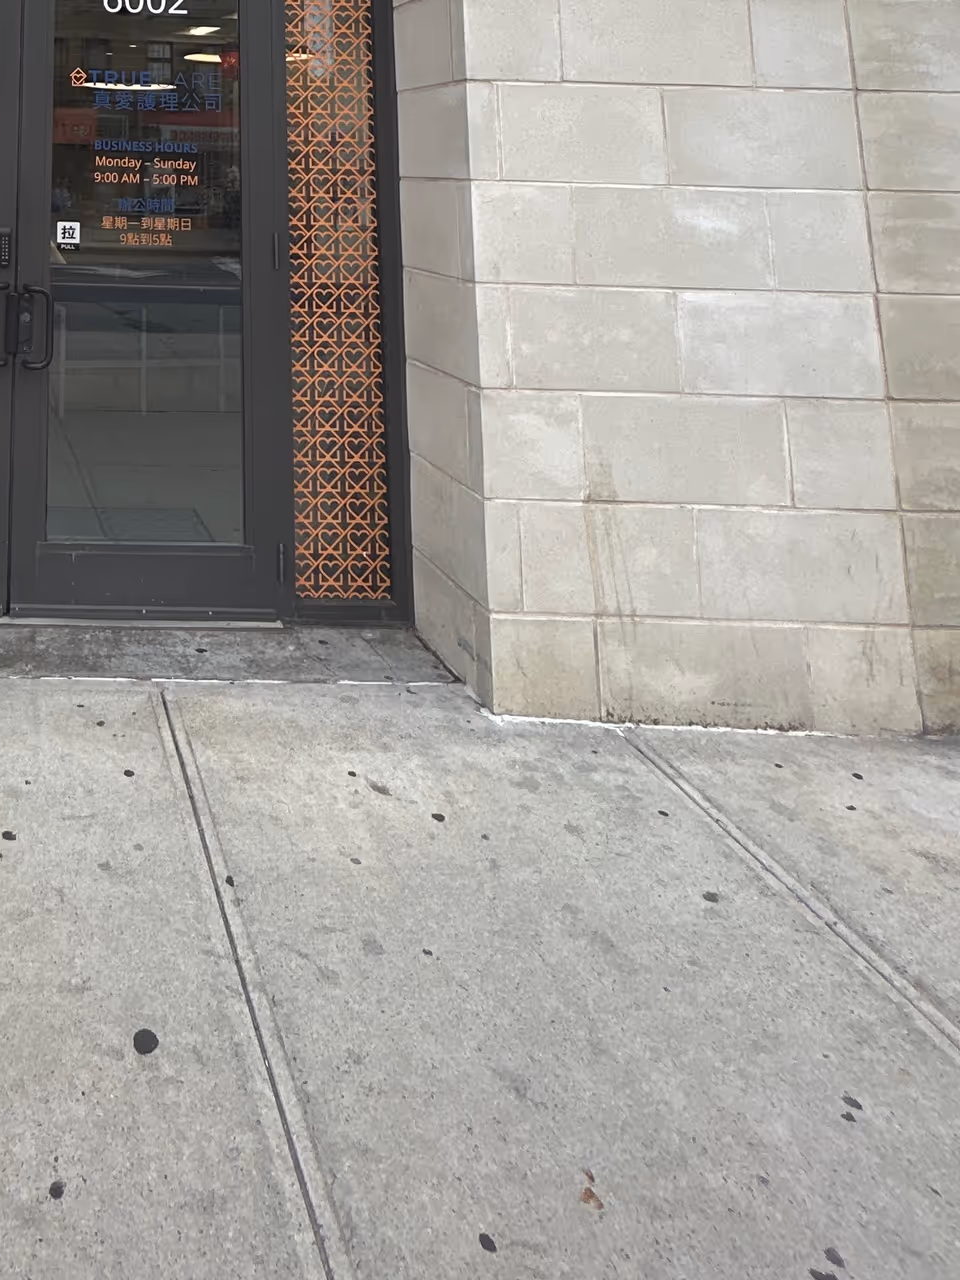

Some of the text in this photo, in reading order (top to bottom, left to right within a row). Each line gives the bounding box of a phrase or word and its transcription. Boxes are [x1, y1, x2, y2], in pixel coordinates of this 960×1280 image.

[88, 69, 222, 90] TRUECARE
[93, 91, 222, 113] 真愛護理公司
[94, 140, 198, 154] BUSINESS HOURS
[95, 156, 142, 170] Monday
[153, 158, 196, 172] Sunday
[94, 172, 118, 183] 9:00
[121, 174, 140, 184] AM
[152, 174, 177, 185] 5:00
[180, 175, 198, 186] PM
[101, 216, 192, 231] 星期一到星期日
[61, 225, 76, 240] 拉
[119, 233, 172, 246] 9點到5點
